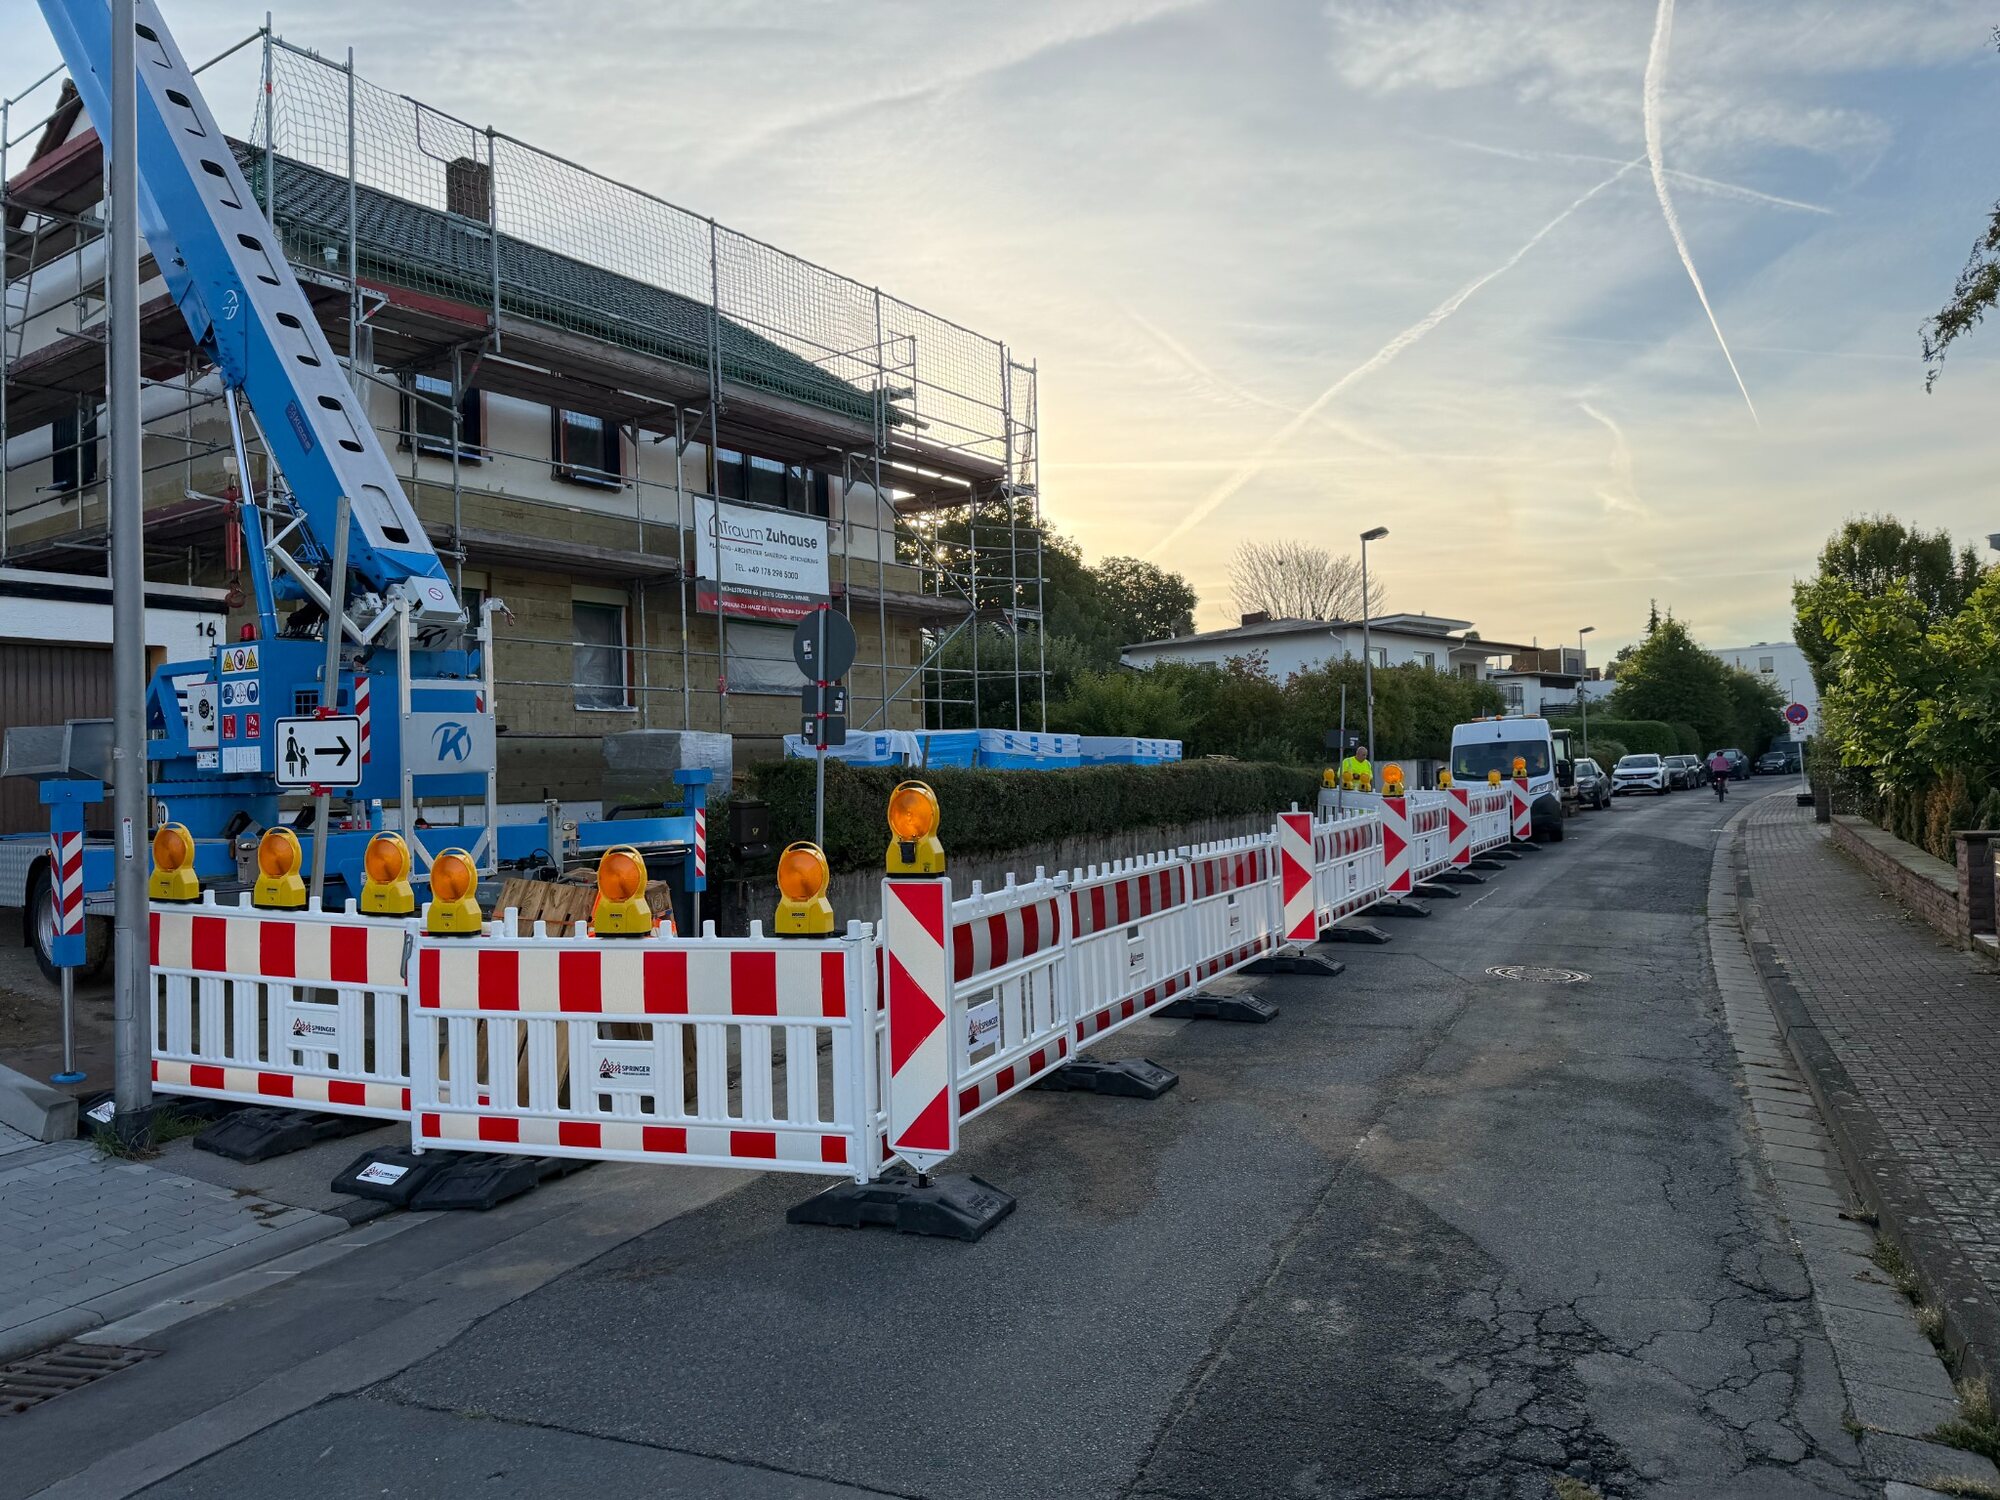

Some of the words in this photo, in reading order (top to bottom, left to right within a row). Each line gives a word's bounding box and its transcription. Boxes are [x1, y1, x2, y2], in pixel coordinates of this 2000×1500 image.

[722, 520, 764, 540] Traum
[766, 527, 818, 549] Zuhause
[735, 563, 747, 572] TEL.
[748, 566, 759, 574] +49
[196, 621, 216, 637] 16
[438, 725, 468, 761] K
[311, 1024, 336, 1033] SPRINGER
[621, 1064, 651, 1073] SPRINGER
